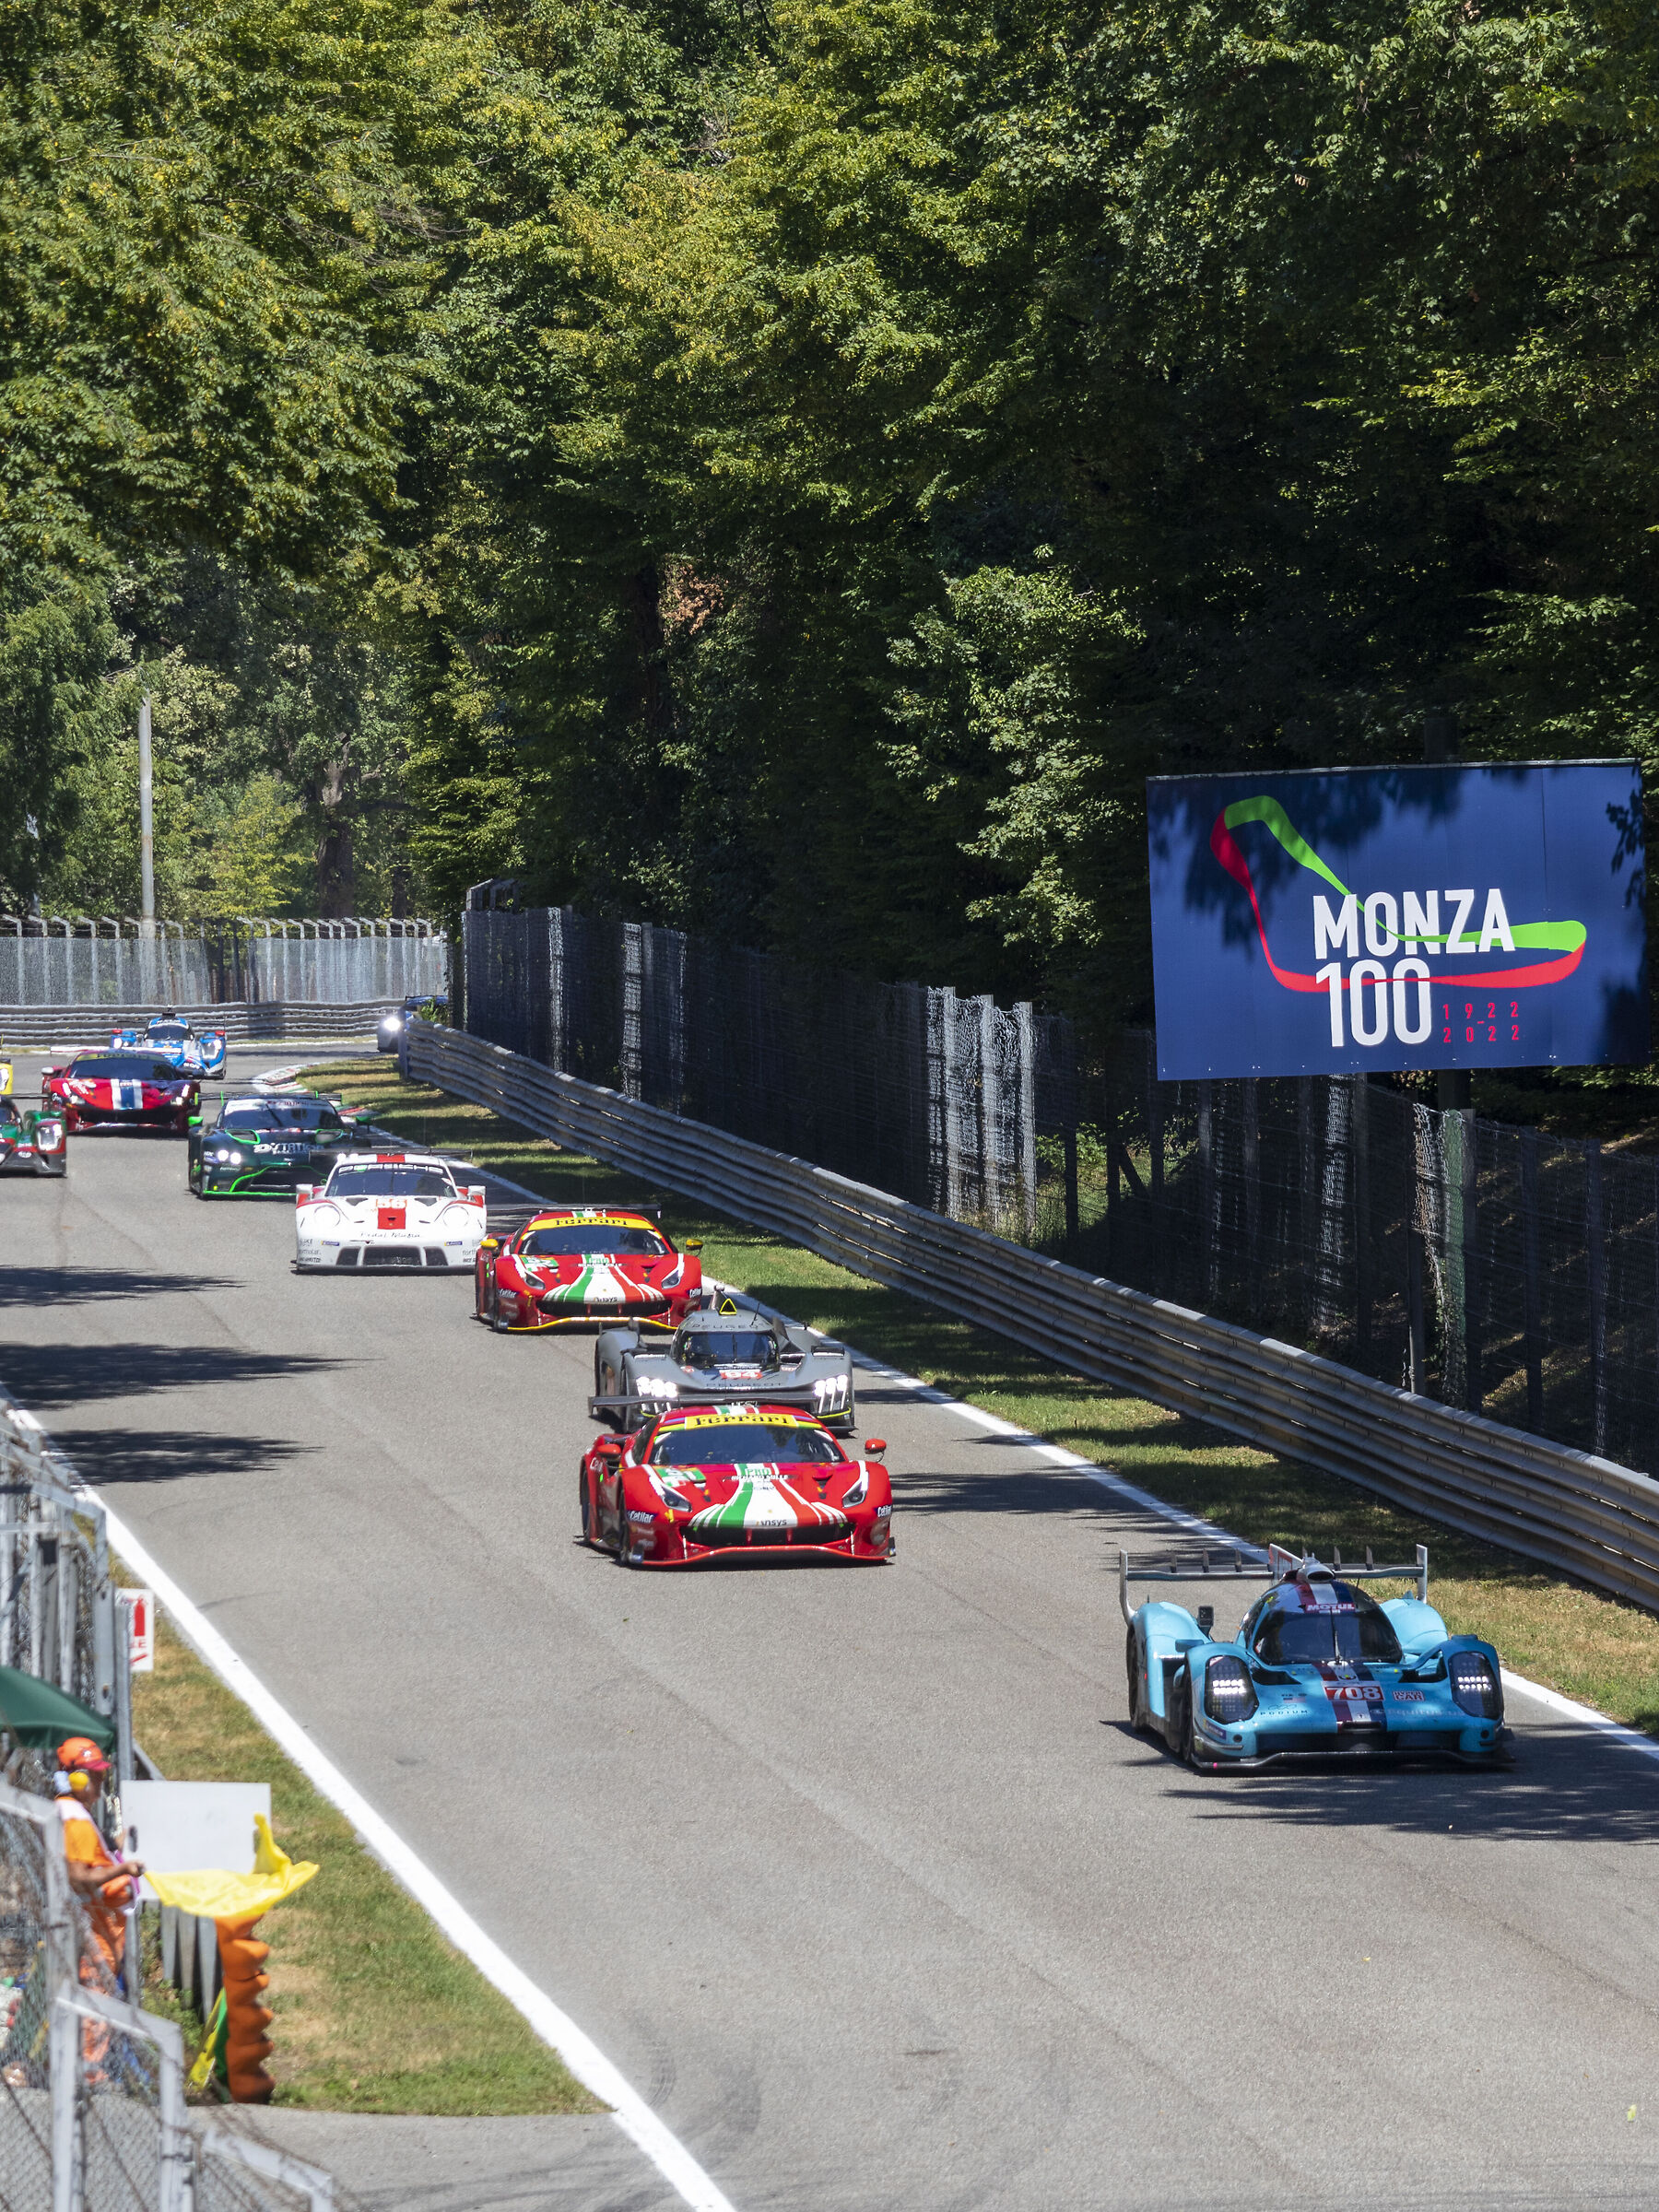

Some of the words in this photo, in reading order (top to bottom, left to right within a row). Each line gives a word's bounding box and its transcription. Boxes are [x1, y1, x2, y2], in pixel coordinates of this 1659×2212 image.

[1312, 888, 1516, 959] MONZA
[1315, 958, 1432, 1048] 100
[695, 1415, 789, 1426] Ferrari
[1325, 1687, 1382, 1700] 708
